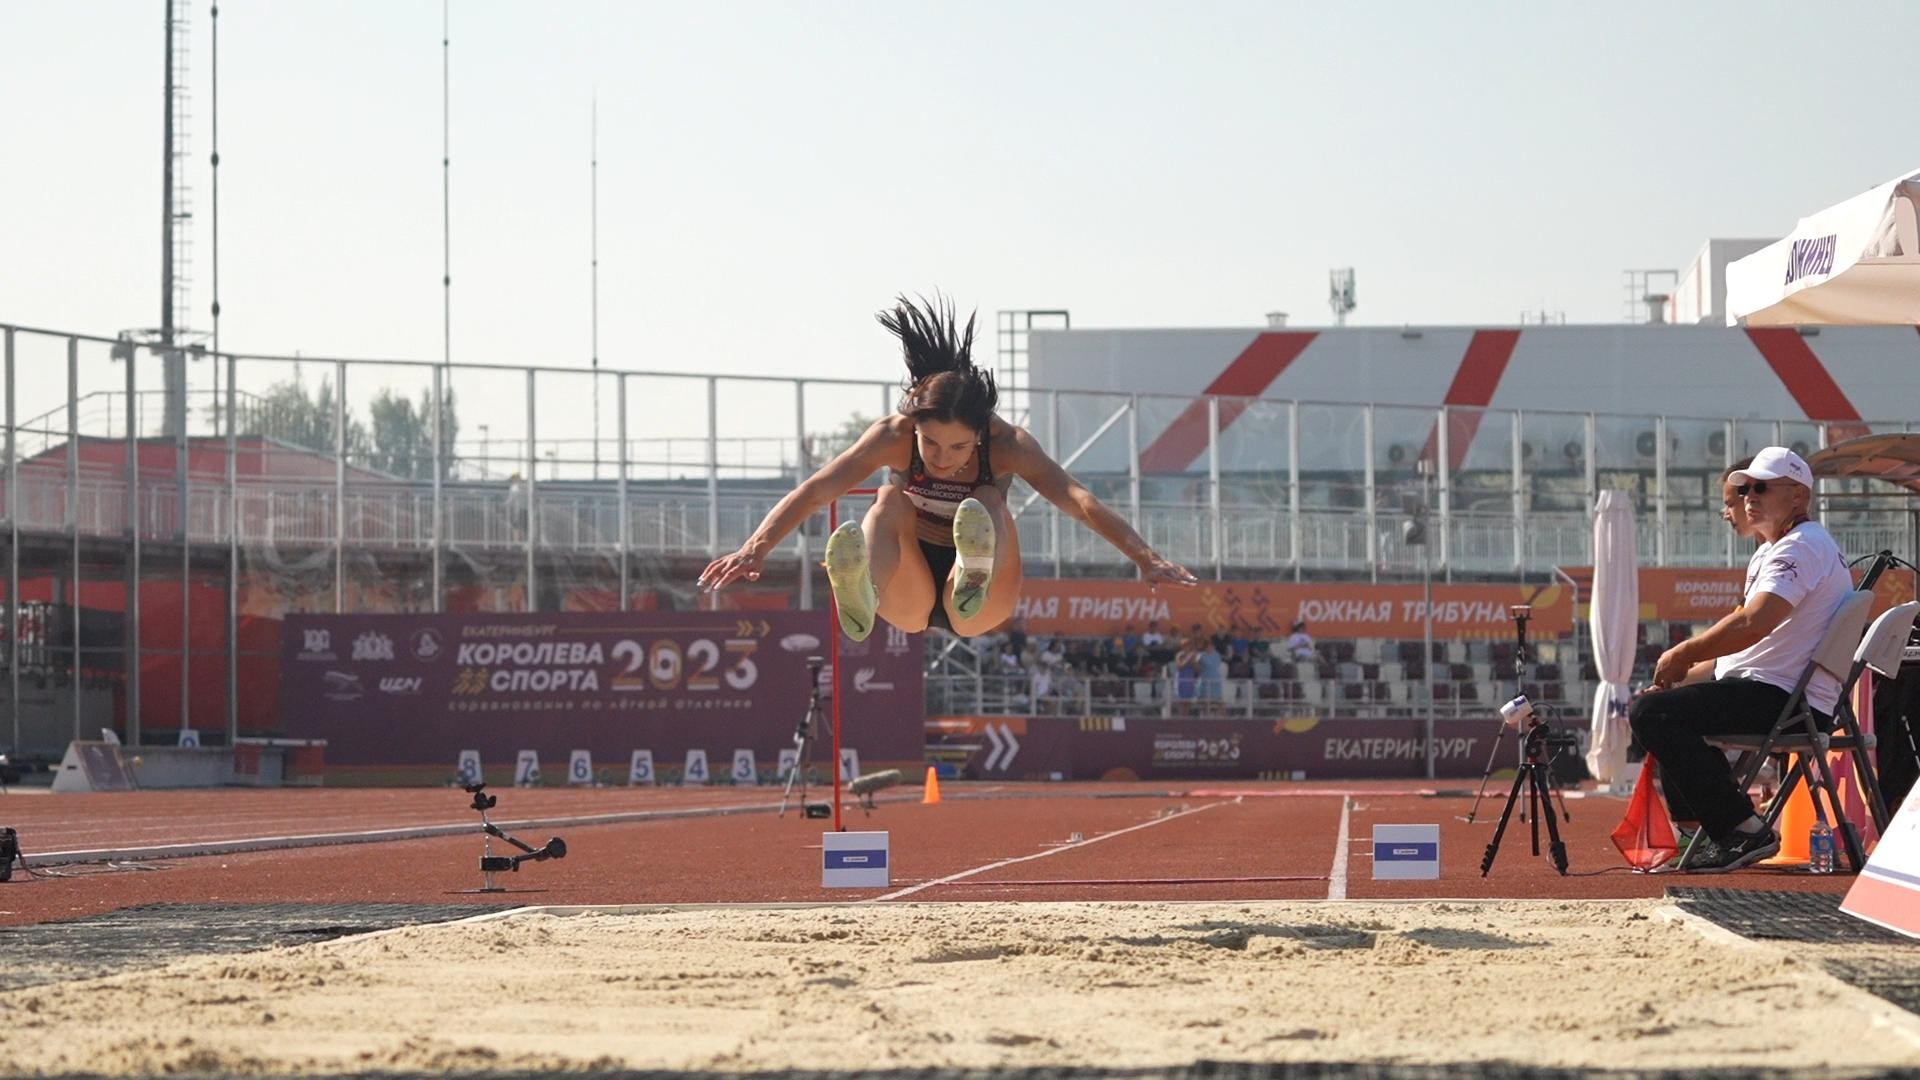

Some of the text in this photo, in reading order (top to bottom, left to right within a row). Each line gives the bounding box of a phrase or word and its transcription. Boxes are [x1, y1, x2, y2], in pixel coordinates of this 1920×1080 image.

[1674, 582, 1741, 593] КОРОЛЕВА
[1014, 597, 1171, 621] НАЯ ТРИБУНА
[1299, 600, 1508, 624] ЮЖНАЯ ТРИБУНА
[456, 643, 604, 666] КОРОЛЕВА
[611, 638, 758, 691] 2023
[490, 670, 599, 692] СПОРТА
[1325, 738, 1477, 760] ЕКАТЕРИНБУРГ
[463, 758, 477, 779] 8
[520, 758, 535, 782] 7
[573, 758, 588, 778] 6
[634, 757, 650, 779] 5
[688, 757, 705, 779] 4
[736, 757, 752, 779] 3
